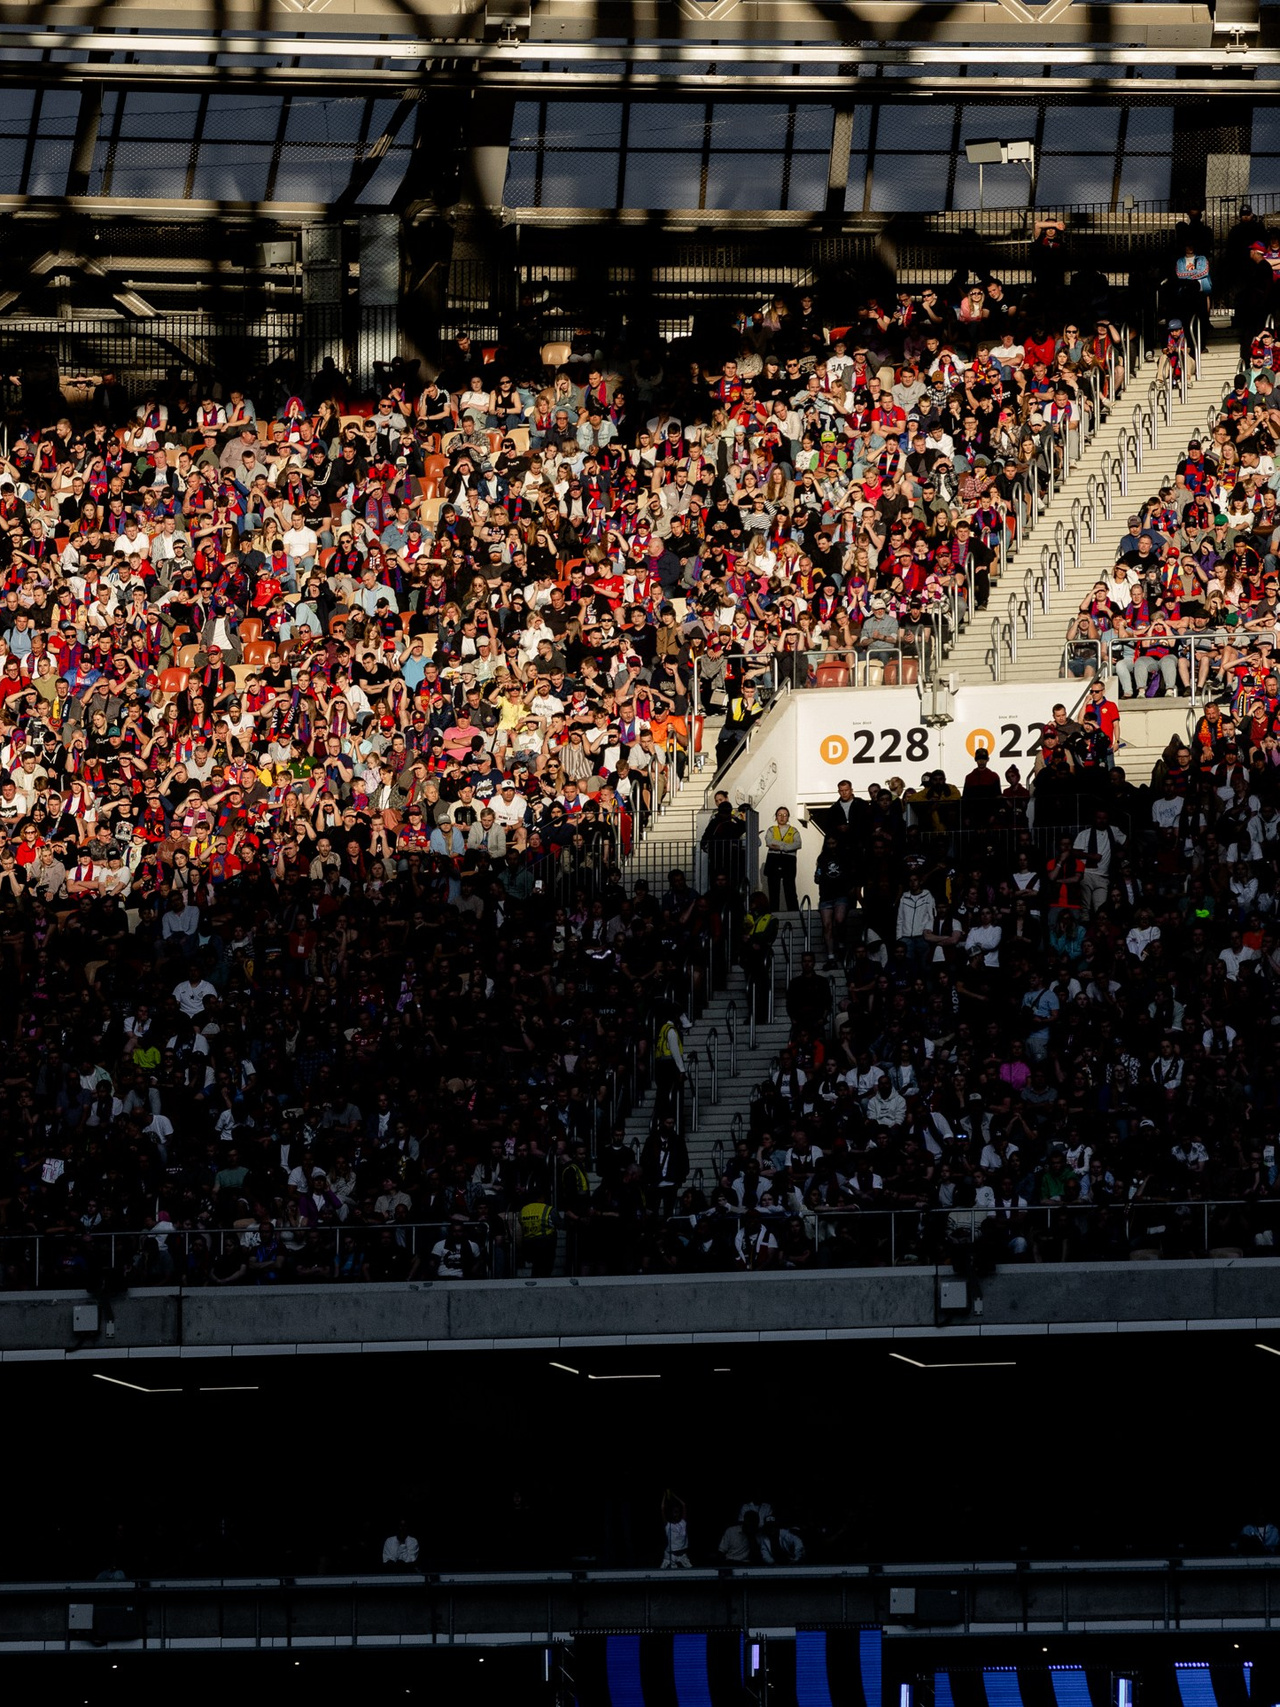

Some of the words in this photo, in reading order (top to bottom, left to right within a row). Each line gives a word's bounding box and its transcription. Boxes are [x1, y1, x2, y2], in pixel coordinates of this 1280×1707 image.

[828, 741, 843, 759] D
[852, 727, 930, 764] 228
[974, 735, 989, 752] D
[999, 723, 1045, 759] 22
